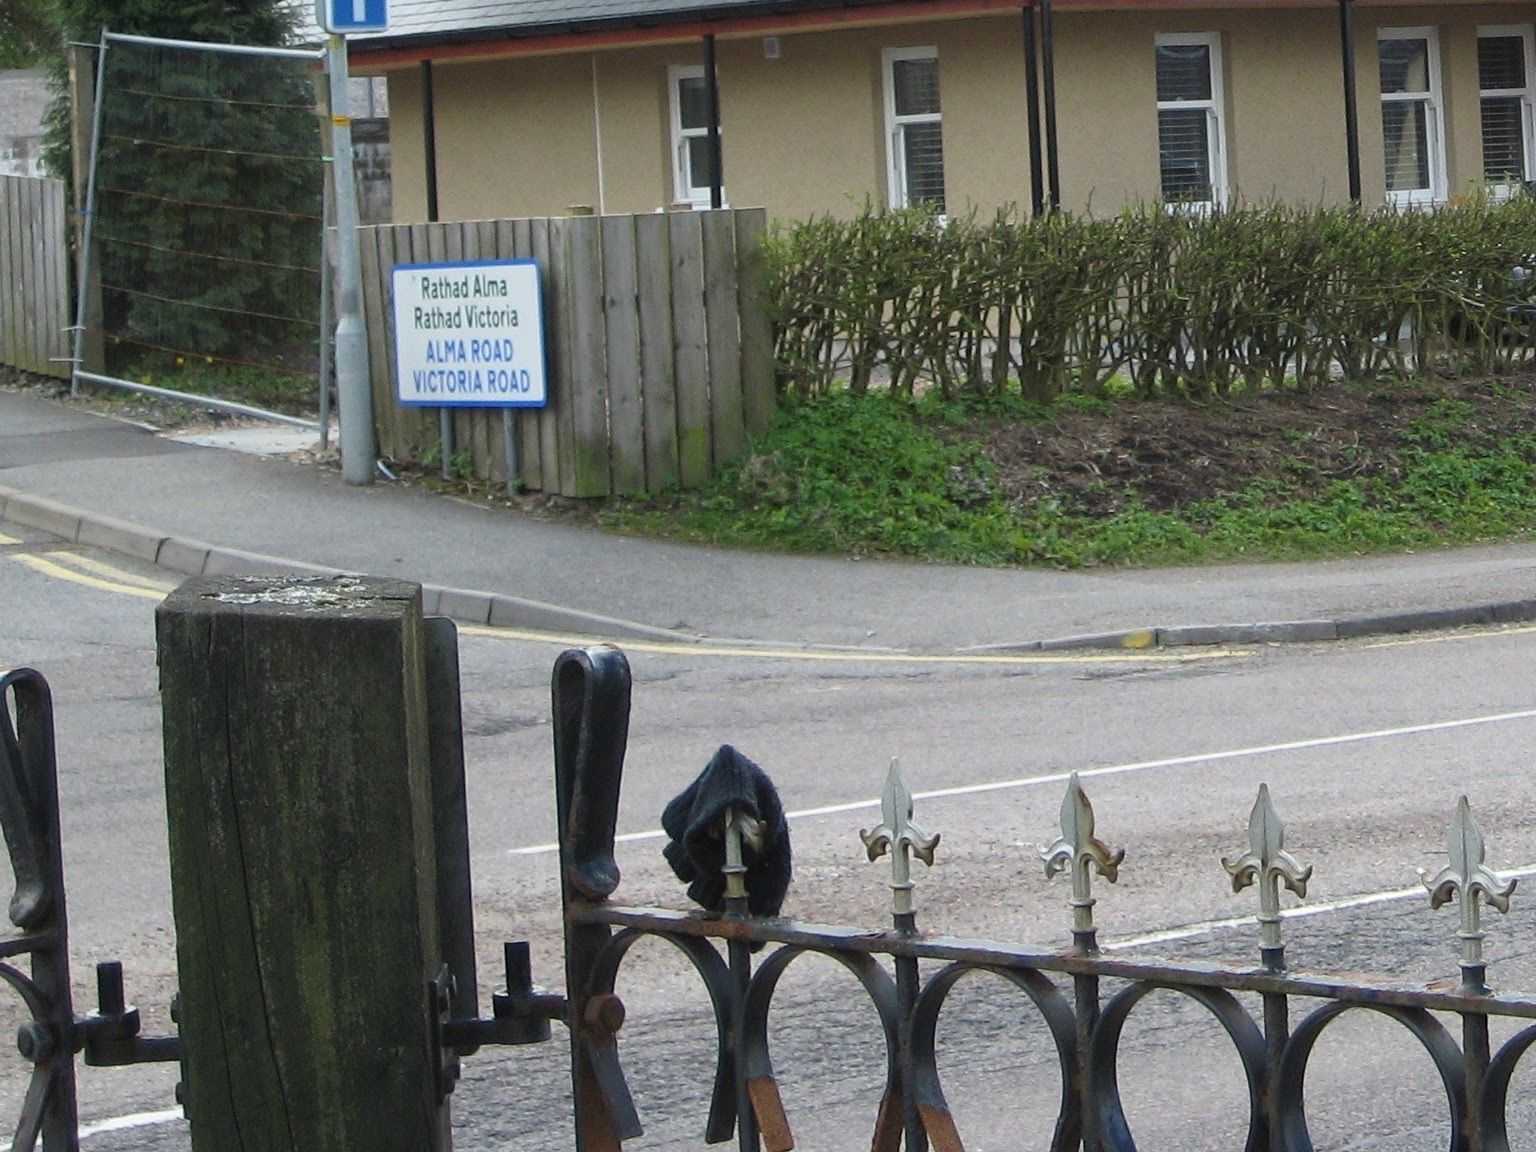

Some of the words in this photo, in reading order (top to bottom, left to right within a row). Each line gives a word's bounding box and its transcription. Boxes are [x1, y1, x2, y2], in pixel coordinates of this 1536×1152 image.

[421, 275, 469, 299] Rathad
[473, 275, 508, 297] Alma
[414, 306, 462, 329] Rathad
[464, 305, 519, 328] Victoria
[426, 339, 466, 363] ALMA
[471, 339, 514, 363] ROAD
[413, 370, 483, 393] VICTORIA
[487, 369, 531, 393] ROAD
